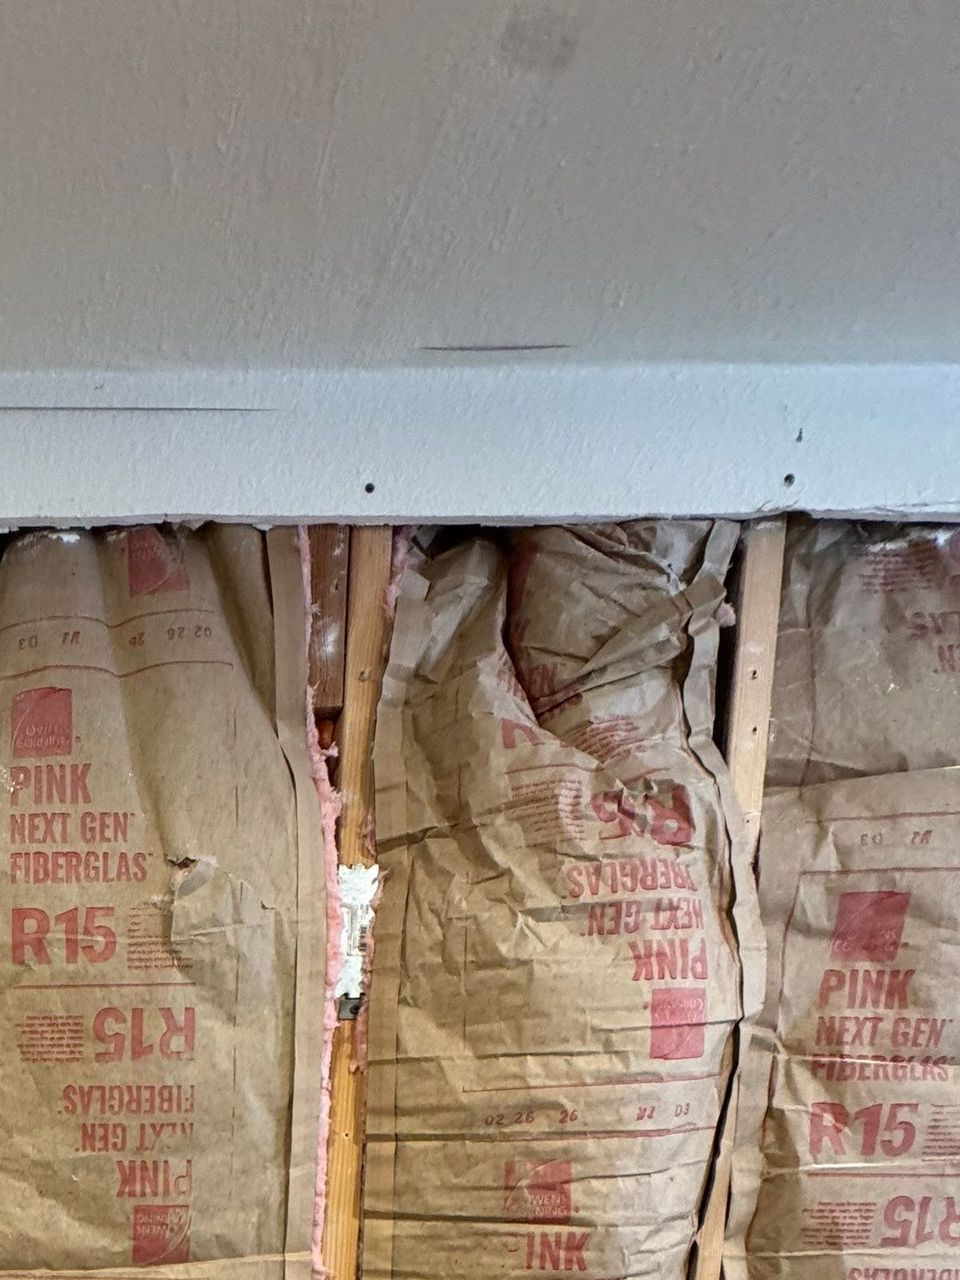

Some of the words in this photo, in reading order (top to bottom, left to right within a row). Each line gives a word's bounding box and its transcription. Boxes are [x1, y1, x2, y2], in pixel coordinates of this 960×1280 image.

[18, 636, 38, 650] D3
[193, 626, 213, 640] 02
[9, 762, 92, 807] PINK
[9, 812, 70, 844] NEXT
[80, 812, 129, 844] GEN
[9, 851, 148, 885] FIBERGLAS
[587, 901, 641, 937] GEN
[651, 897, 704, 931] NEXT
[11, 906, 117, 966] R15
[628, 938, 709, 982] PINK
[817, 969, 916, 1010] PINK
[92, 1006, 196, 1064] R15
[814, 1016, 884, 1047] NEXT
[890, 1017, 946, 1048] GEN
[811, 1053, 951, 1082] FIBERGLAS
[62, 1084, 195, 1117] FIBERGLAS
[79, 1121, 127, 1153] GEN
[485, 1114, 505, 1127] 02
[808, 1101, 919, 1157] R15
[116, 1158, 193, 1198] PINK
